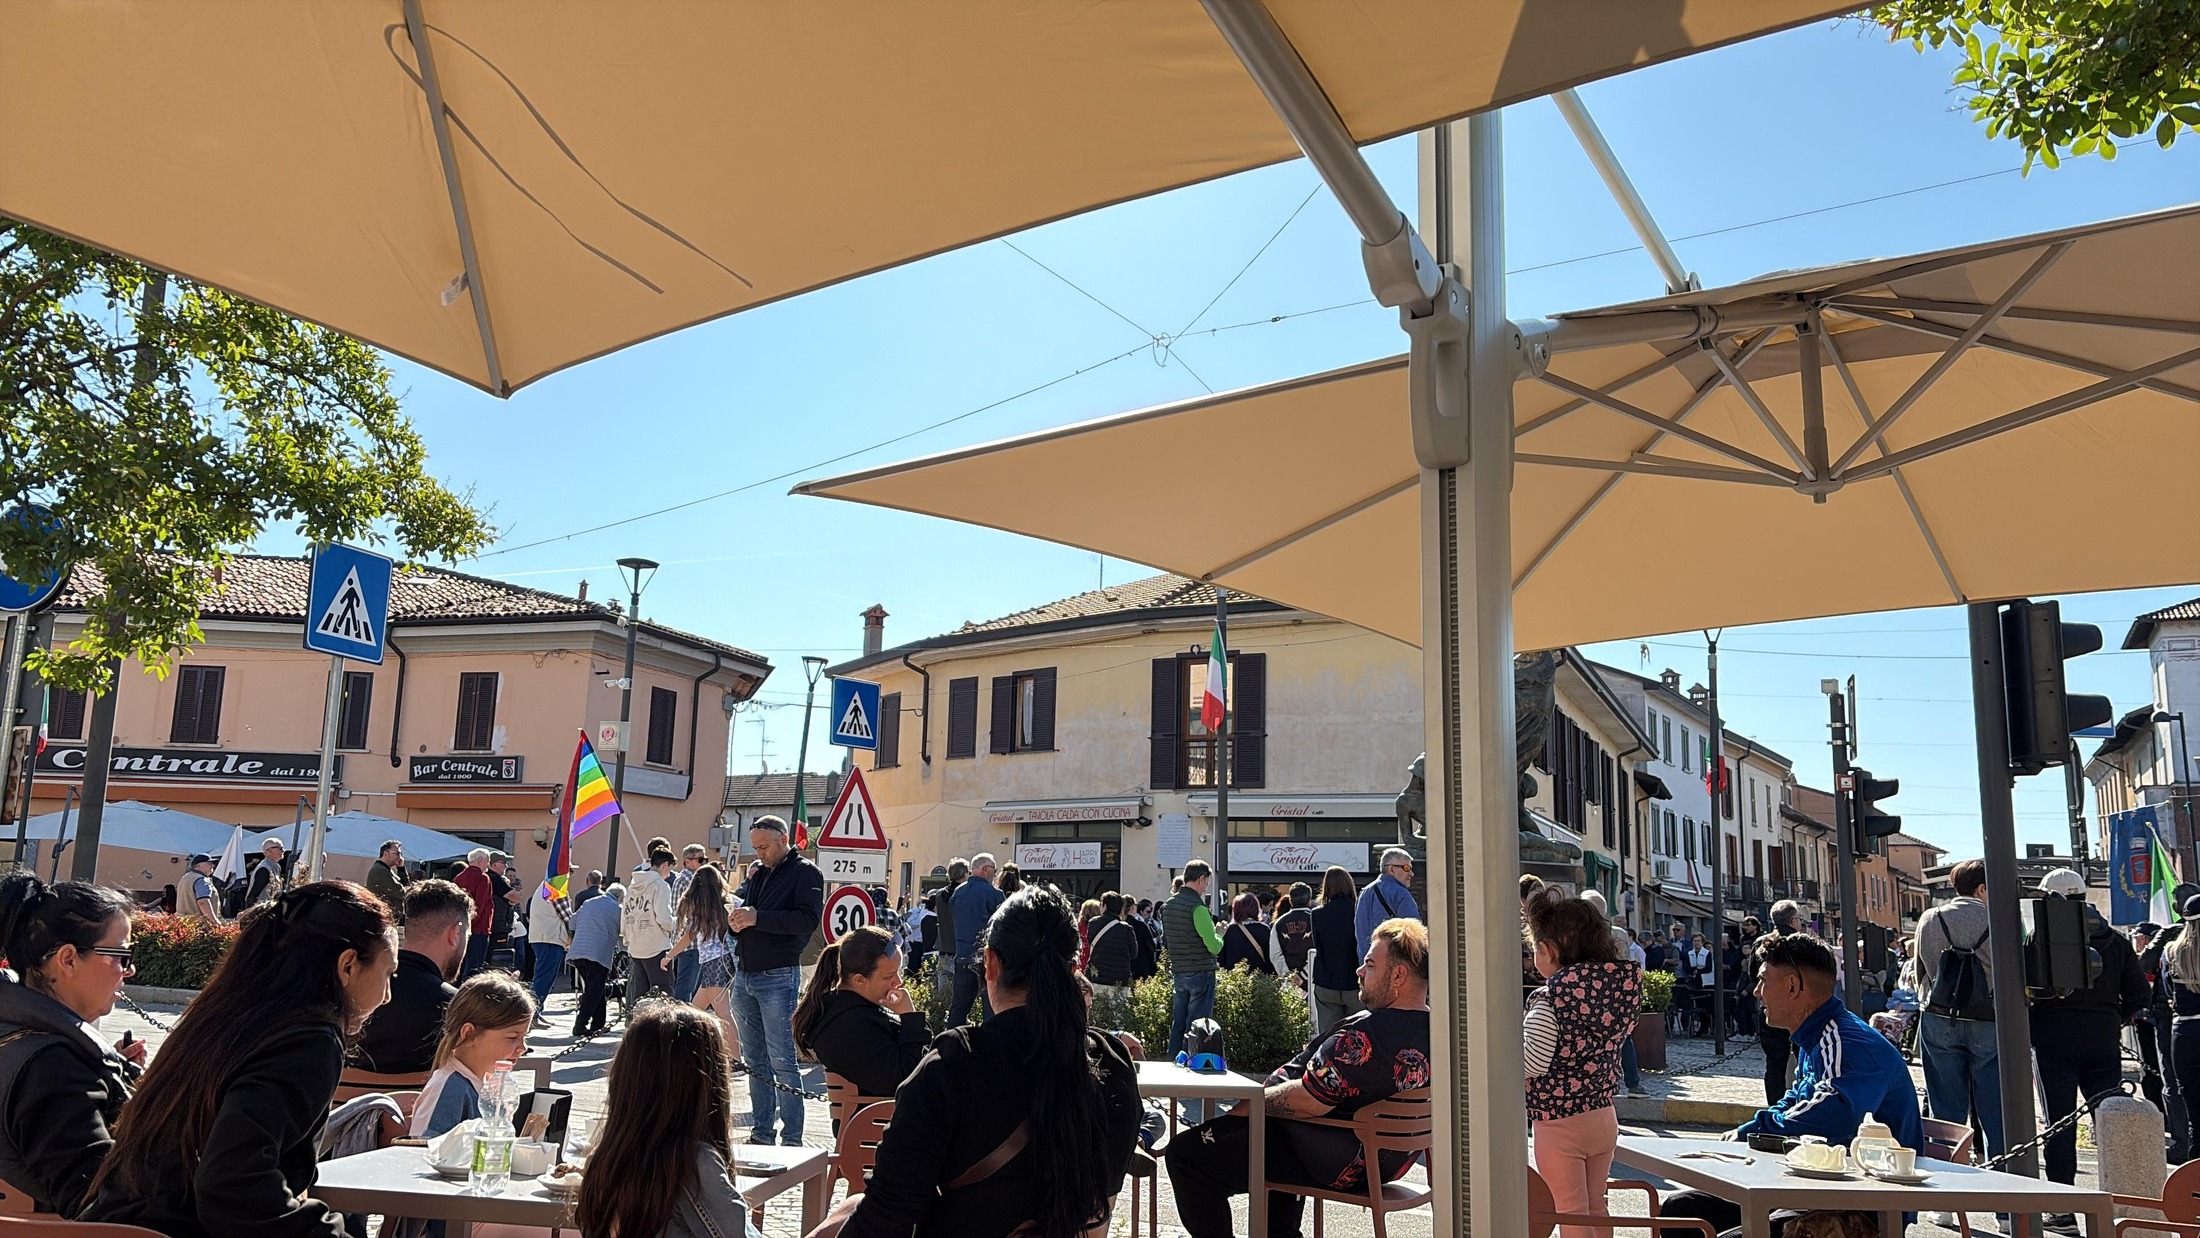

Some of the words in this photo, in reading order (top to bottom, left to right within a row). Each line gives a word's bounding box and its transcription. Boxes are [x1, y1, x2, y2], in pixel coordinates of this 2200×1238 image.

[53, 749, 264, 775] Cntrale
[270, 768, 294, 776] dal
[413, 763, 438, 778] Bar
[441, 759, 499, 778] Centrale
[989, 811, 1015, 822] Cristal
[1029, 810, 1055, 821] TAVOLA
[1057, 809, 1080, 820] CALDA
[1082, 808, 1099, 819] CON
[1103, 807, 1131, 818] CUCINA
[1271, 804, 1309, 816] Cristal
[1024, 850, 1056, 863] Cristal
[1271, 850, 1316, 864] Cristal
[834, 860, 857, 873] 275
[863, 865, 872, 874] m
[834, 904, 865, 937] 30
